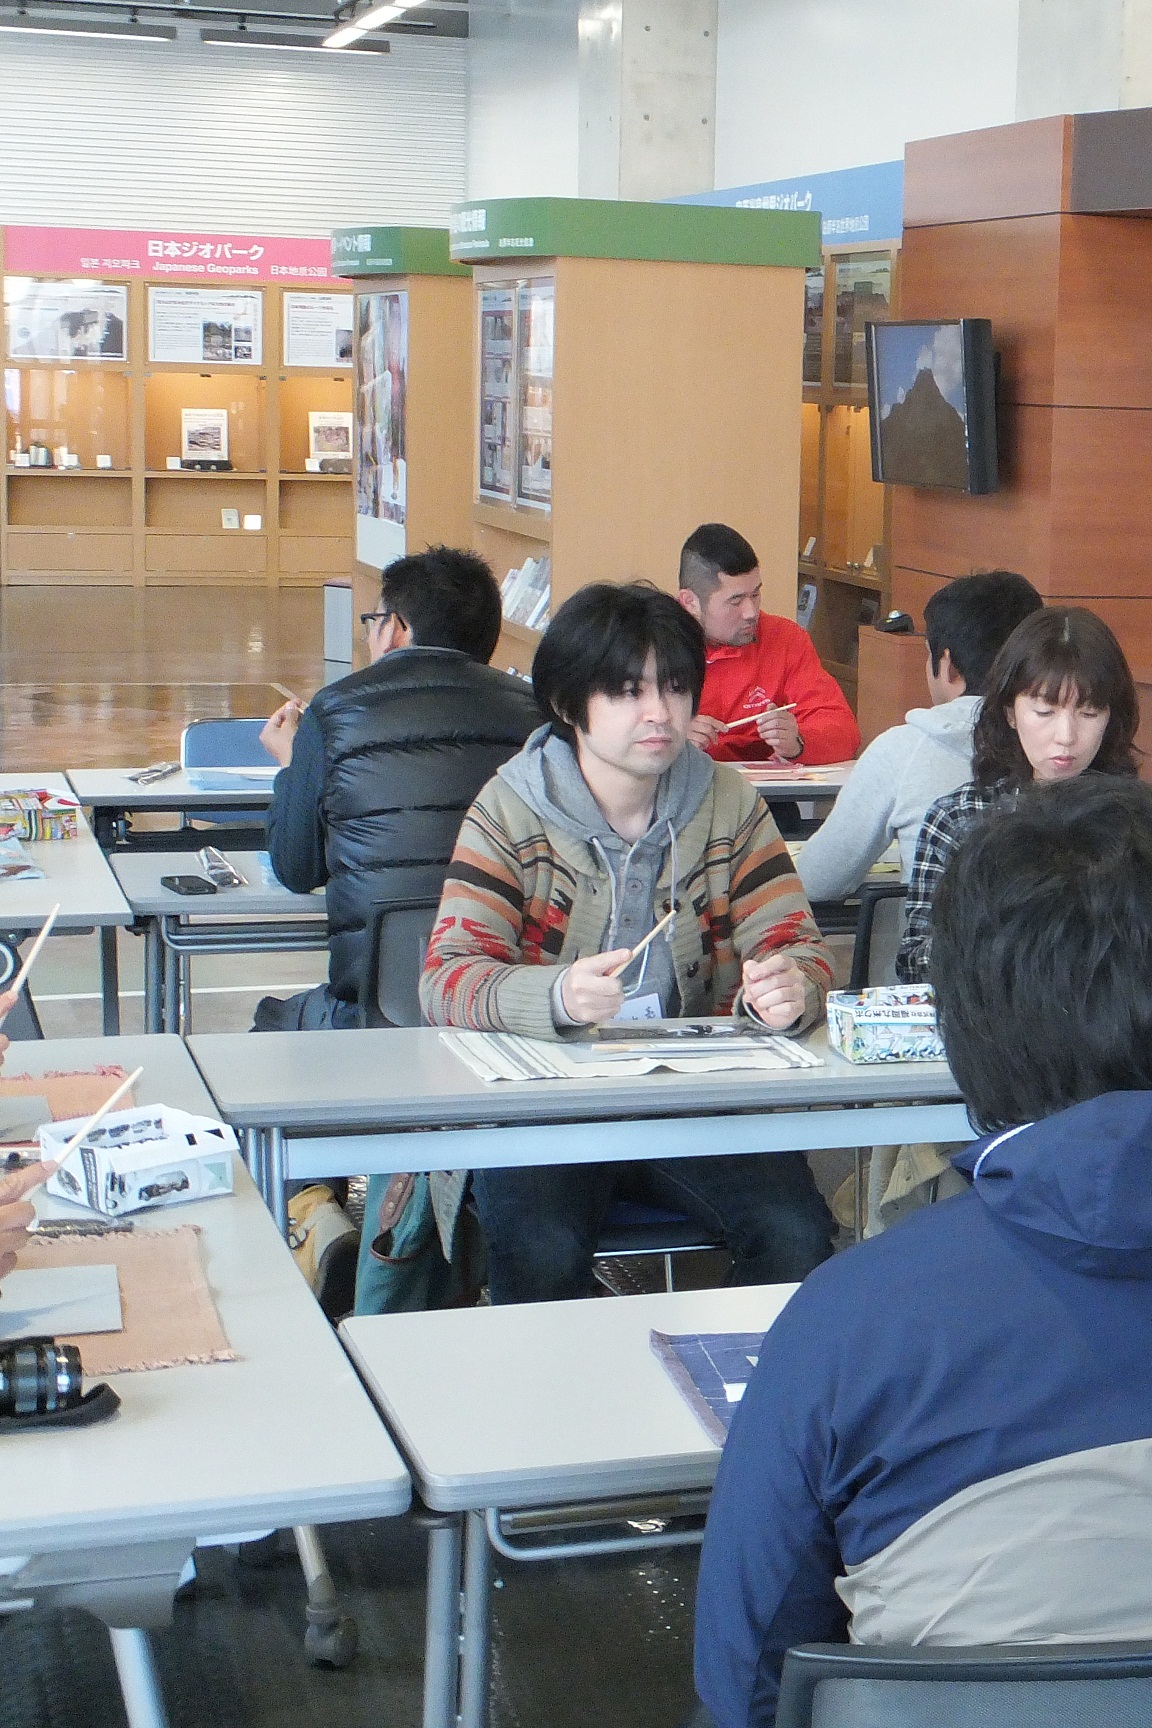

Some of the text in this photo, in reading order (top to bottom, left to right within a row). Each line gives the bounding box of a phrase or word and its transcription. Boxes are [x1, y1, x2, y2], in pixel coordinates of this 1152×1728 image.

[147, 239, 265, 261] 日本ジオパーク
[152, 261, 259, 276] Japanese Geoparks
